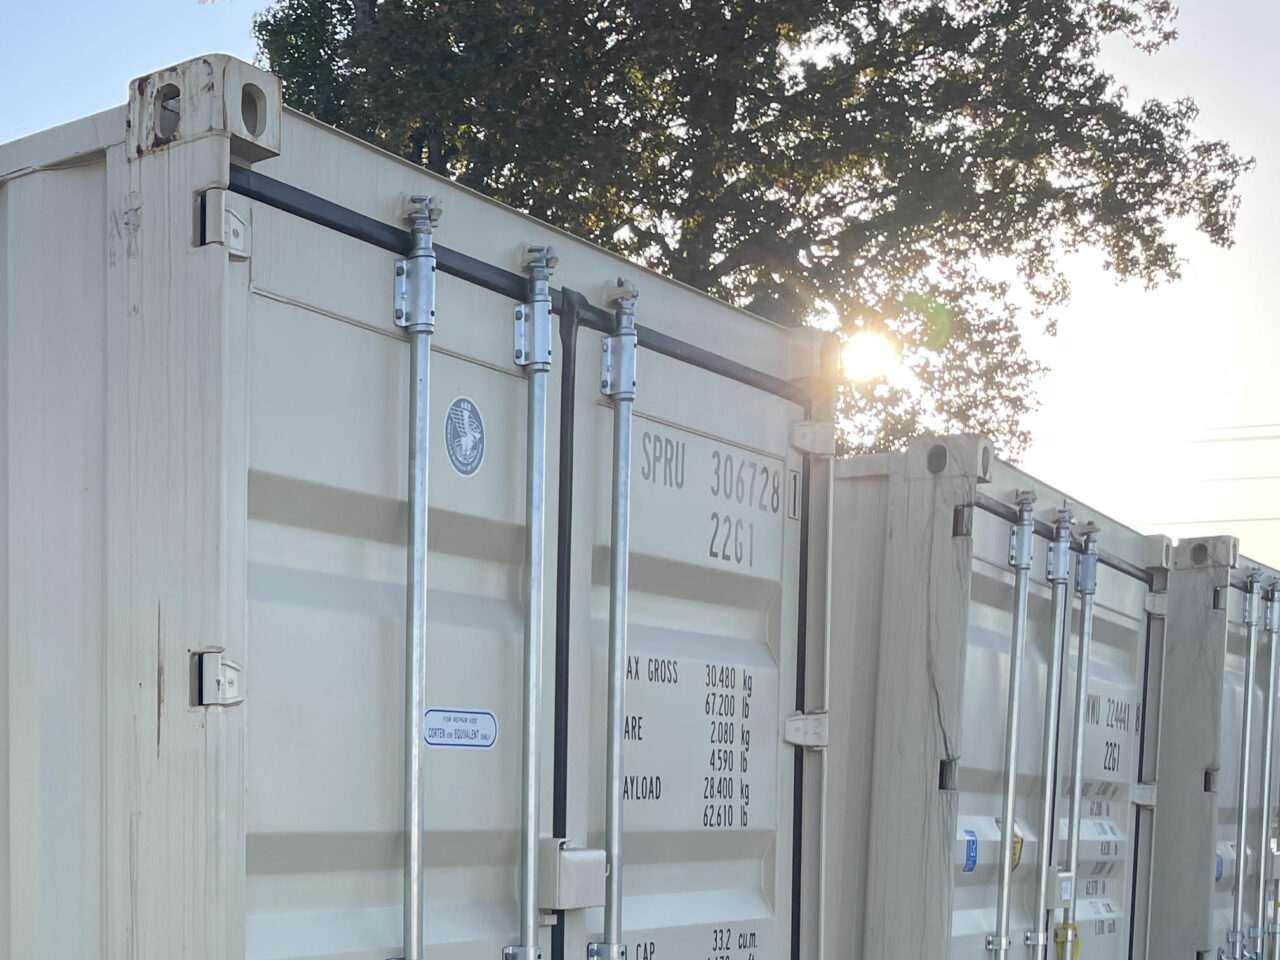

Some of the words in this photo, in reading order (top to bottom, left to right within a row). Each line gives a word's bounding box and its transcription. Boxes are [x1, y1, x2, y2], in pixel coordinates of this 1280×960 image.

[641, 431, 686, 489] SPRU
[710, 450, 780, 514] 306728
[709, 511, 754, 567] 22G1
[626, 655, 640, 680] AX
[648, 658, 678, 684] GROSS
[705, 664, 736, 689] 30.480
[742, 670, 752, 697] kg
[704, 693, 735, 717] 67.200
[741, 697, 750, 719] lb
[623, 716, 643, 741] ARE
[710, 722, 734, 745] 2.080
[740, 724, 750, 752] kg
[709, 749, 734, 772] 4.590
[740, 751, 748, 773] lb
[622, 776, 661, 800] AYLOAD
[703, 777, 734, 800] 28.400
[740, 778, 750, 805] kg
[703, 804, 734, 828] 62.610
[740, 806, 748, 827] lb
[713, 928, 731, 952] 33.2
